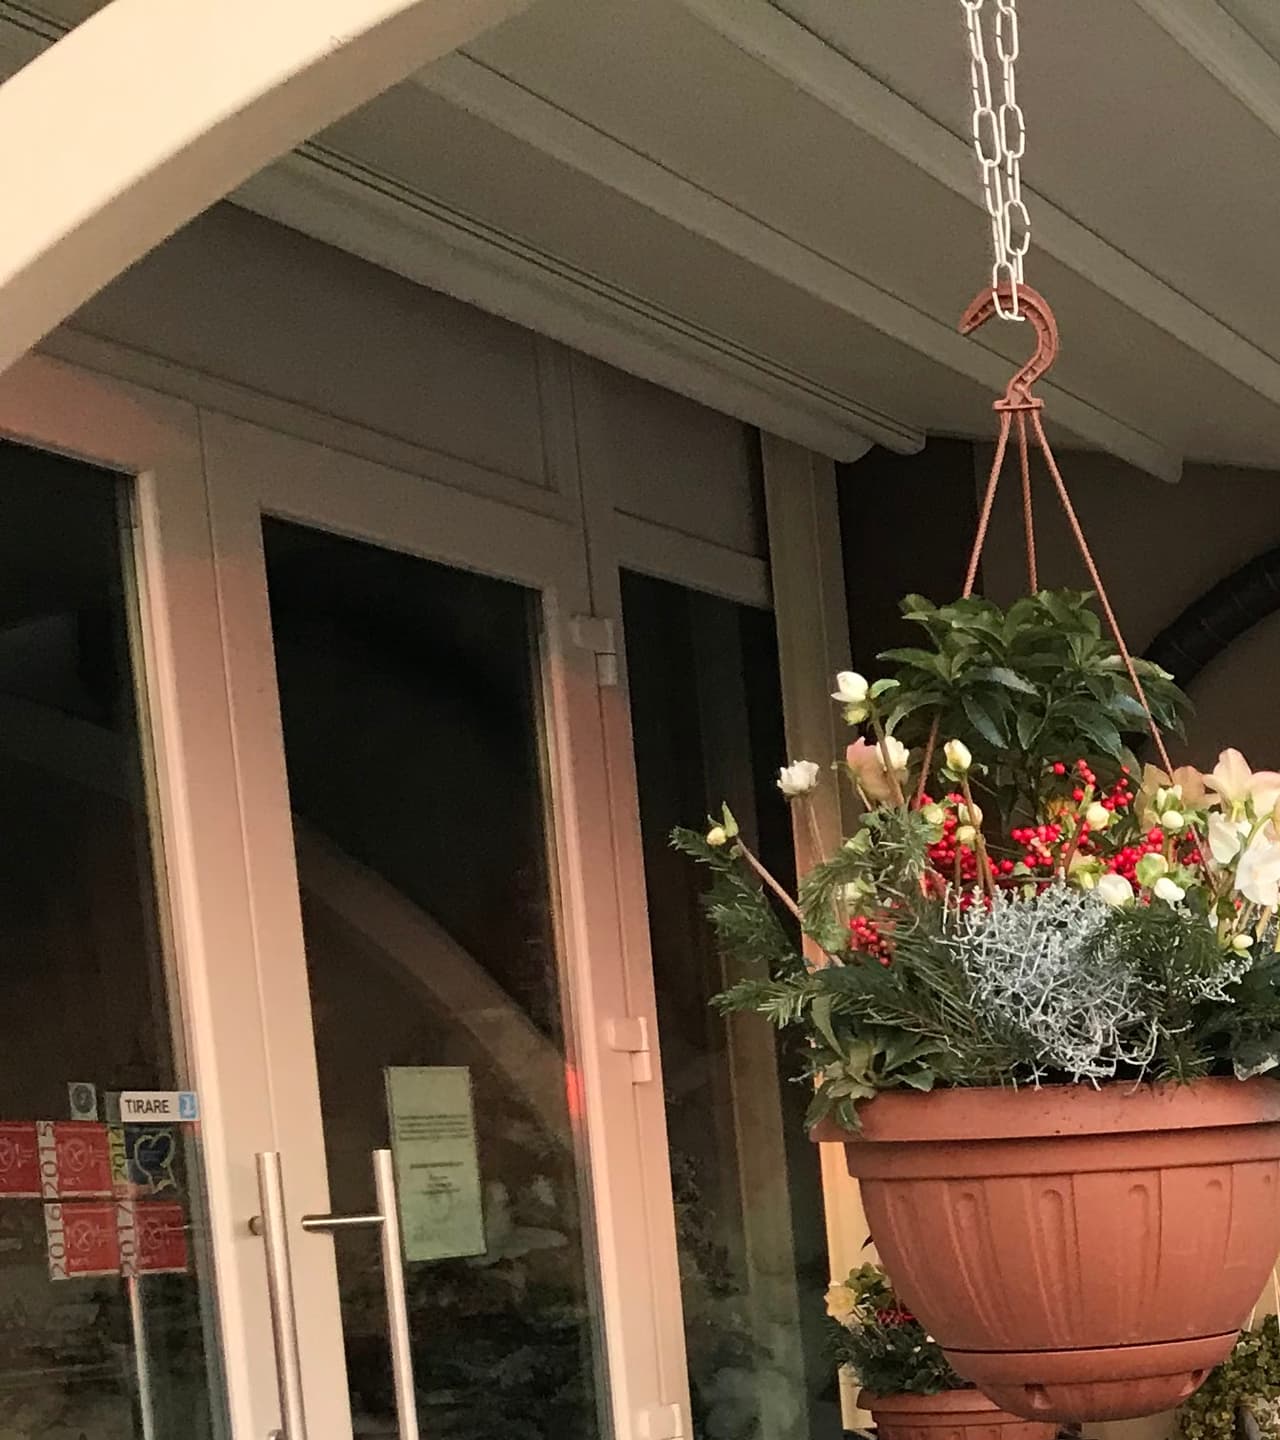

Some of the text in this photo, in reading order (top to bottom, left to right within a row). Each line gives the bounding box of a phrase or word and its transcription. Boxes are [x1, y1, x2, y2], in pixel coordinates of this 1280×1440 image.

[124, 1099, 170, 1113] TIRARE
[39, 1121, 59, 1198] 2015
[47, 1205, 67, 1280] 2016
[118, 1202, 137, 1278] 2017
